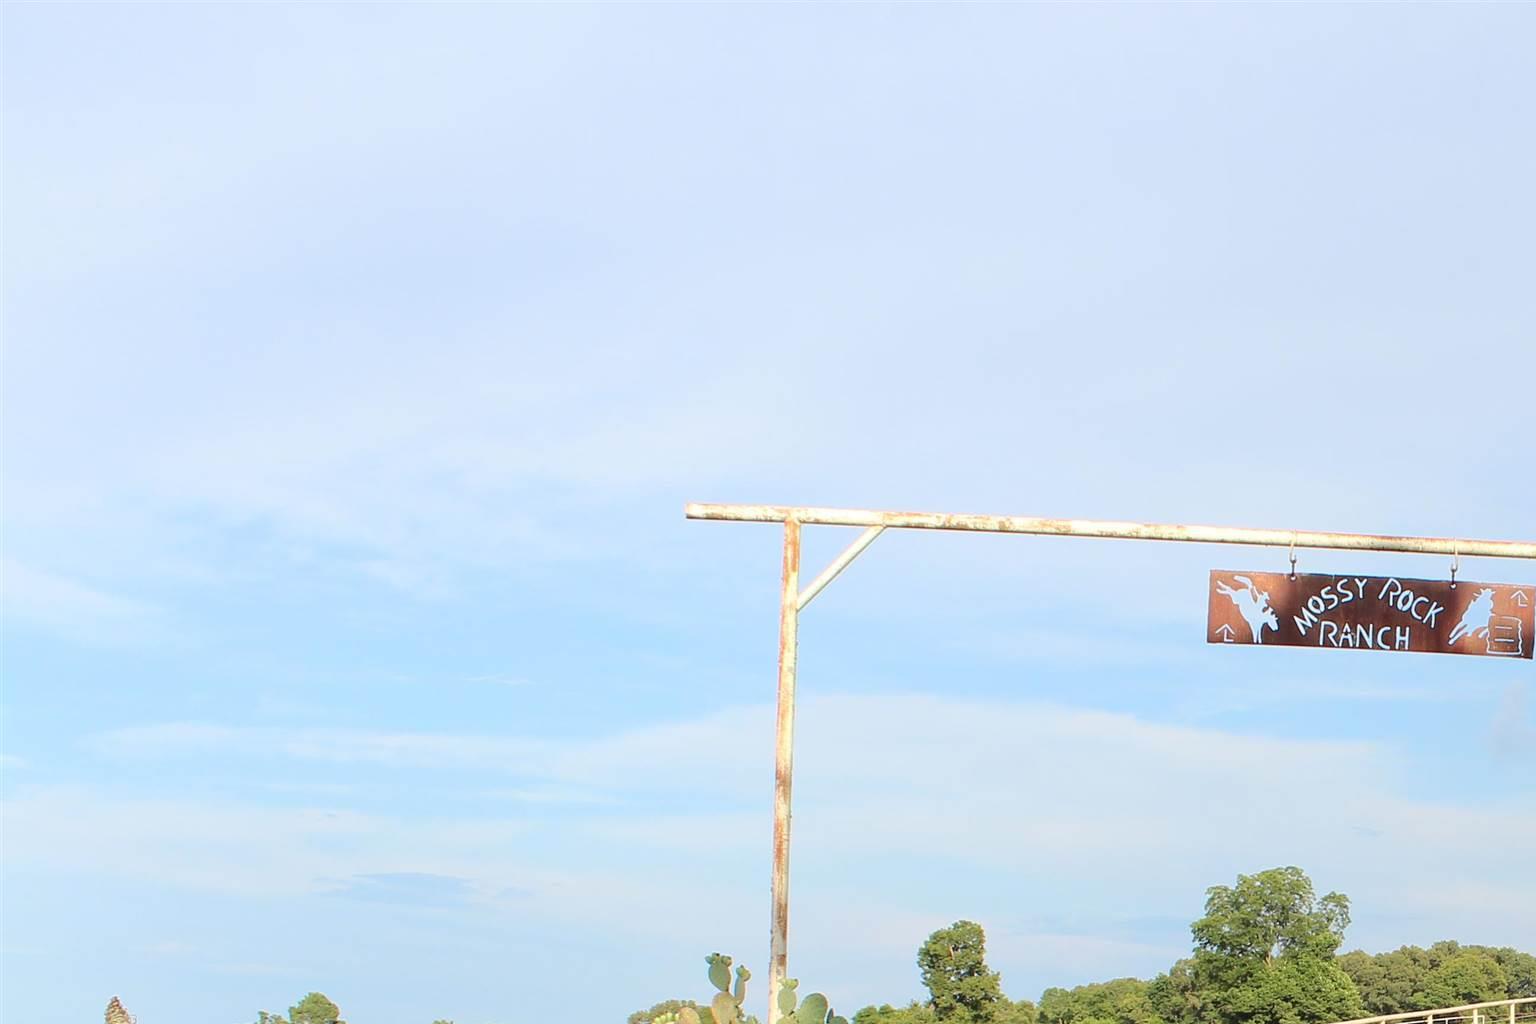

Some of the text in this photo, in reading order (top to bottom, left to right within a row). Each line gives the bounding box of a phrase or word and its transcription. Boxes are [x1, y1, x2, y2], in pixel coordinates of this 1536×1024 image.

[1293, 577, 1444, 636] MOSSY ROCK
[1319, 621, 1410, 651] RANCH
